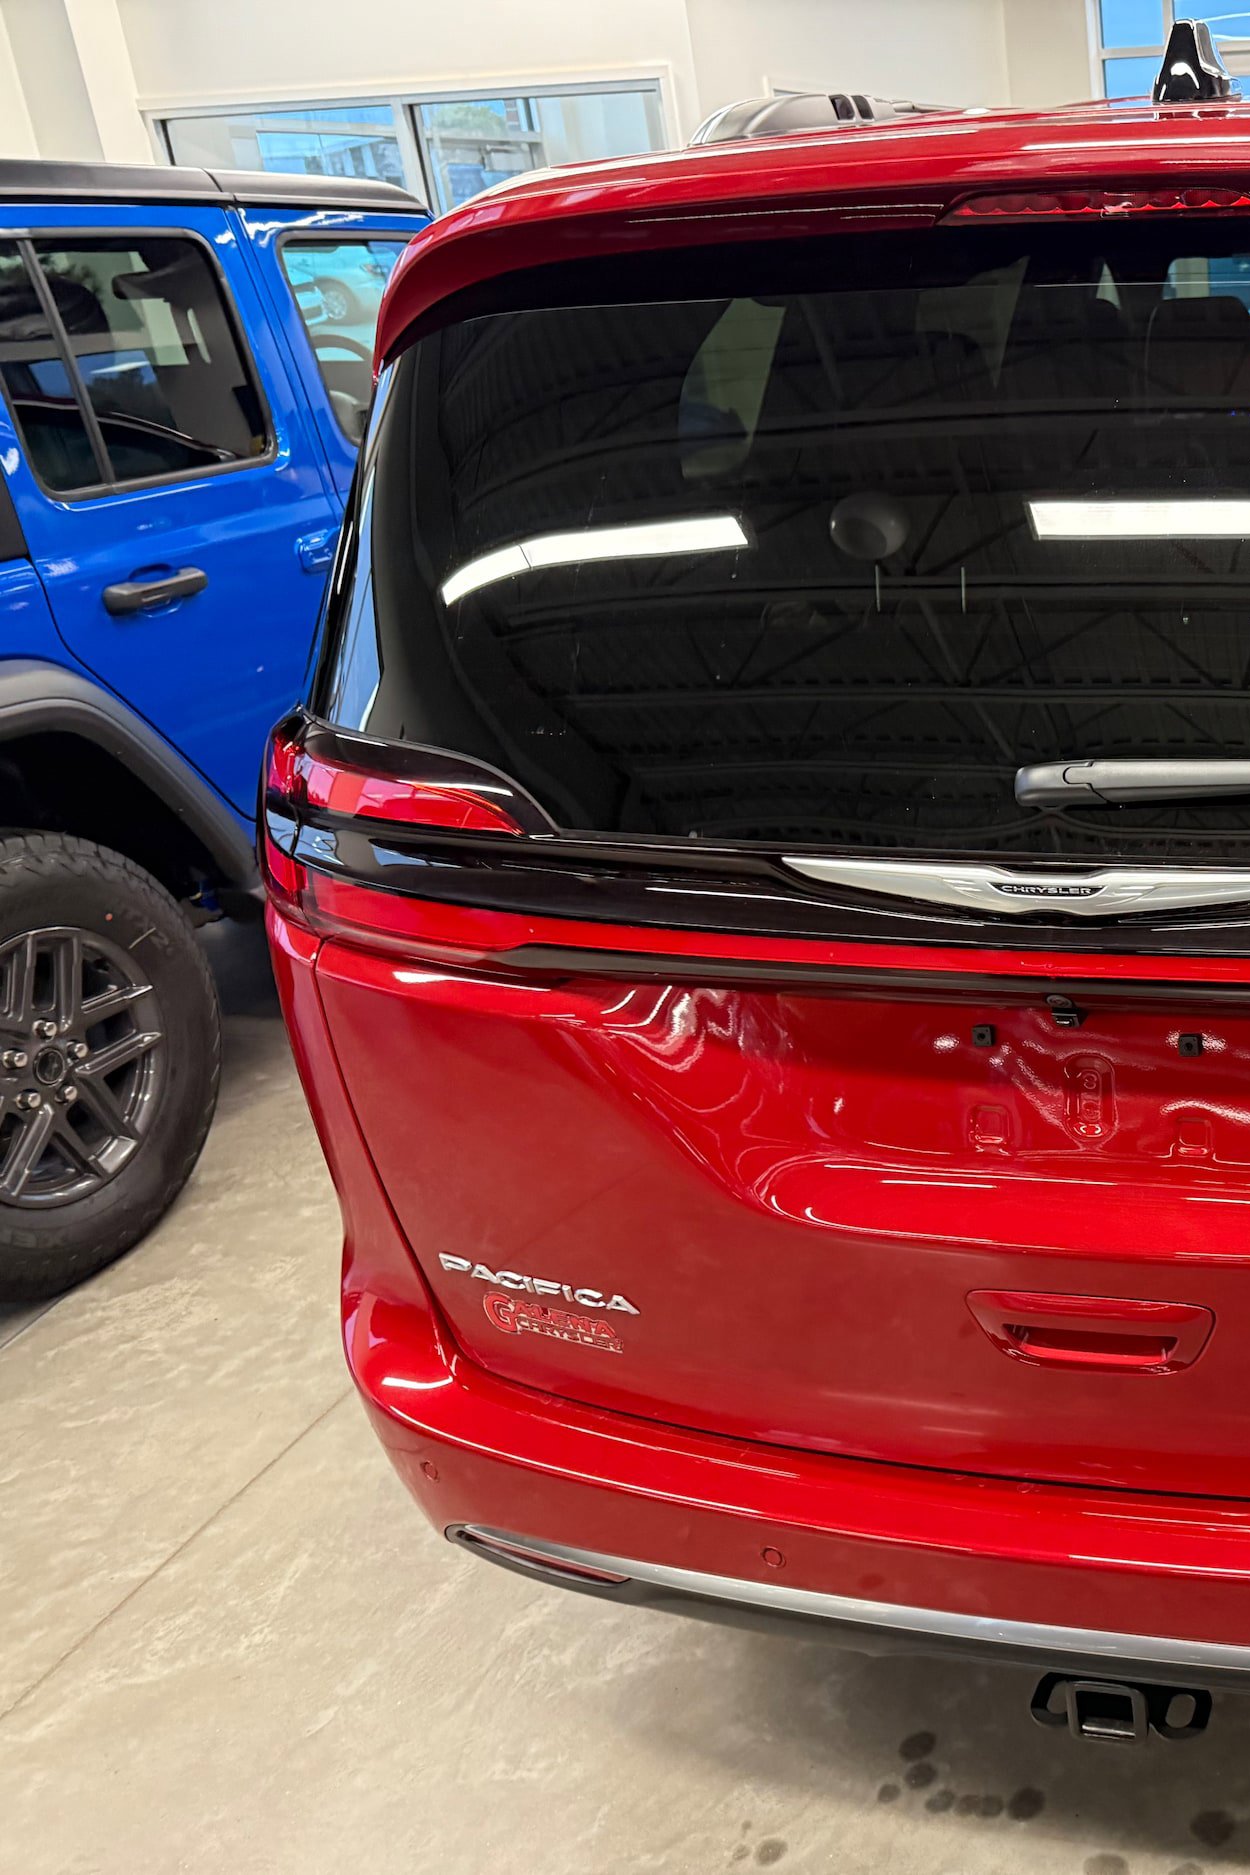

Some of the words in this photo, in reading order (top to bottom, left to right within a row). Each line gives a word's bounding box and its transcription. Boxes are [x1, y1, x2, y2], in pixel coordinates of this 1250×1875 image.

[1001, 885, 1092, 895] CHRYSLER
[439, 1252, 640, 1315] PACIFICA
[483, 1291, 617, 1338] GALENA
[517, 1317, 624, 1351] CHRYSLER
